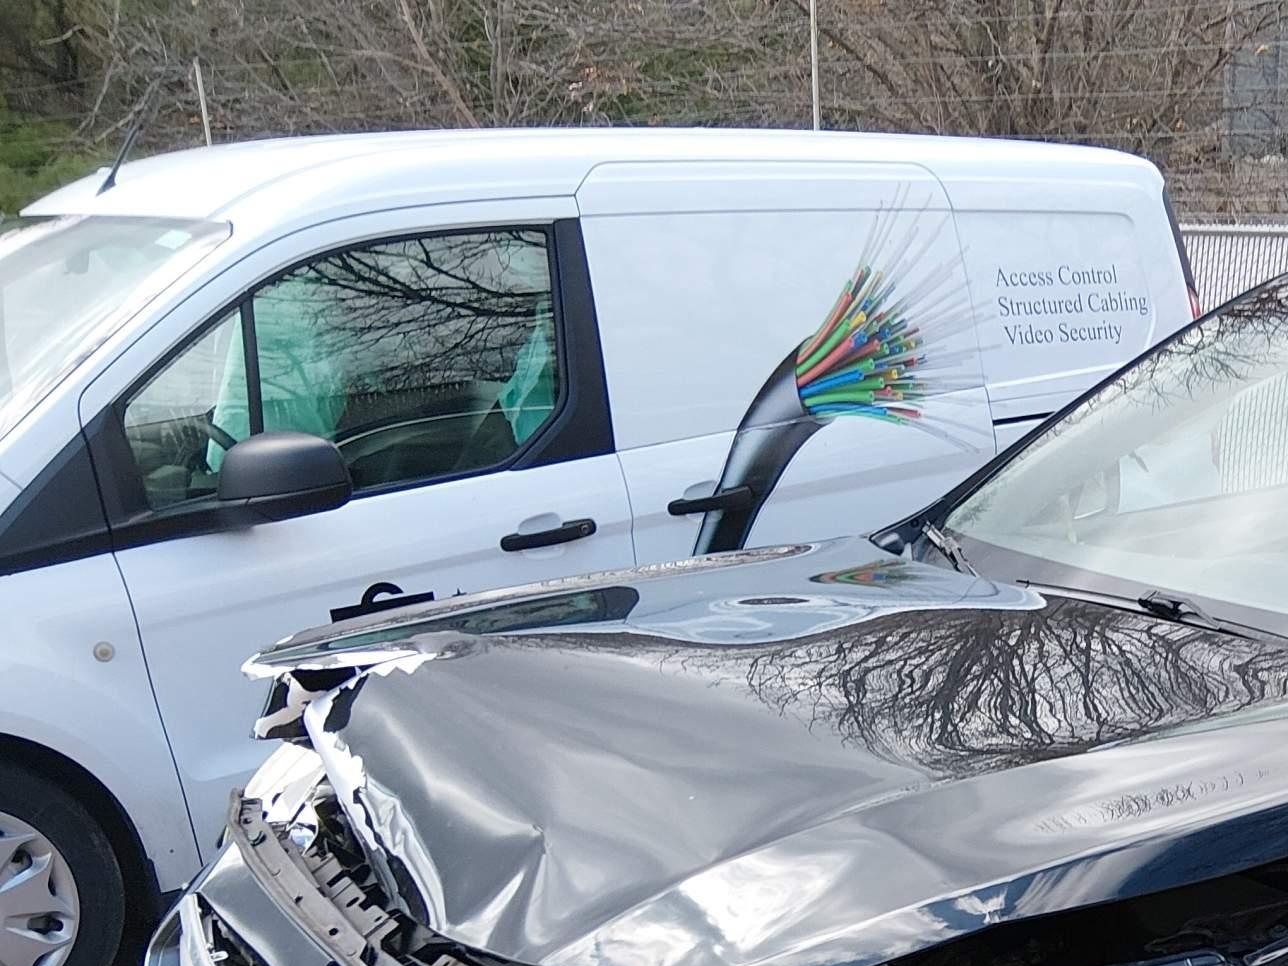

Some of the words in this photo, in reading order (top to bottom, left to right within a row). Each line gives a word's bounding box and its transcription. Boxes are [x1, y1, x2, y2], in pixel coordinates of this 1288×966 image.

[996, 267, 1054, 288] Access
[1058, 264, 1118, 286] Control
[998, 294, 1084, 317] Structured
[1087, 291, 1149, 316] Cabling
[1004, 324, 1054, 346] Video
[1058, 319, 1123, 345] Security
